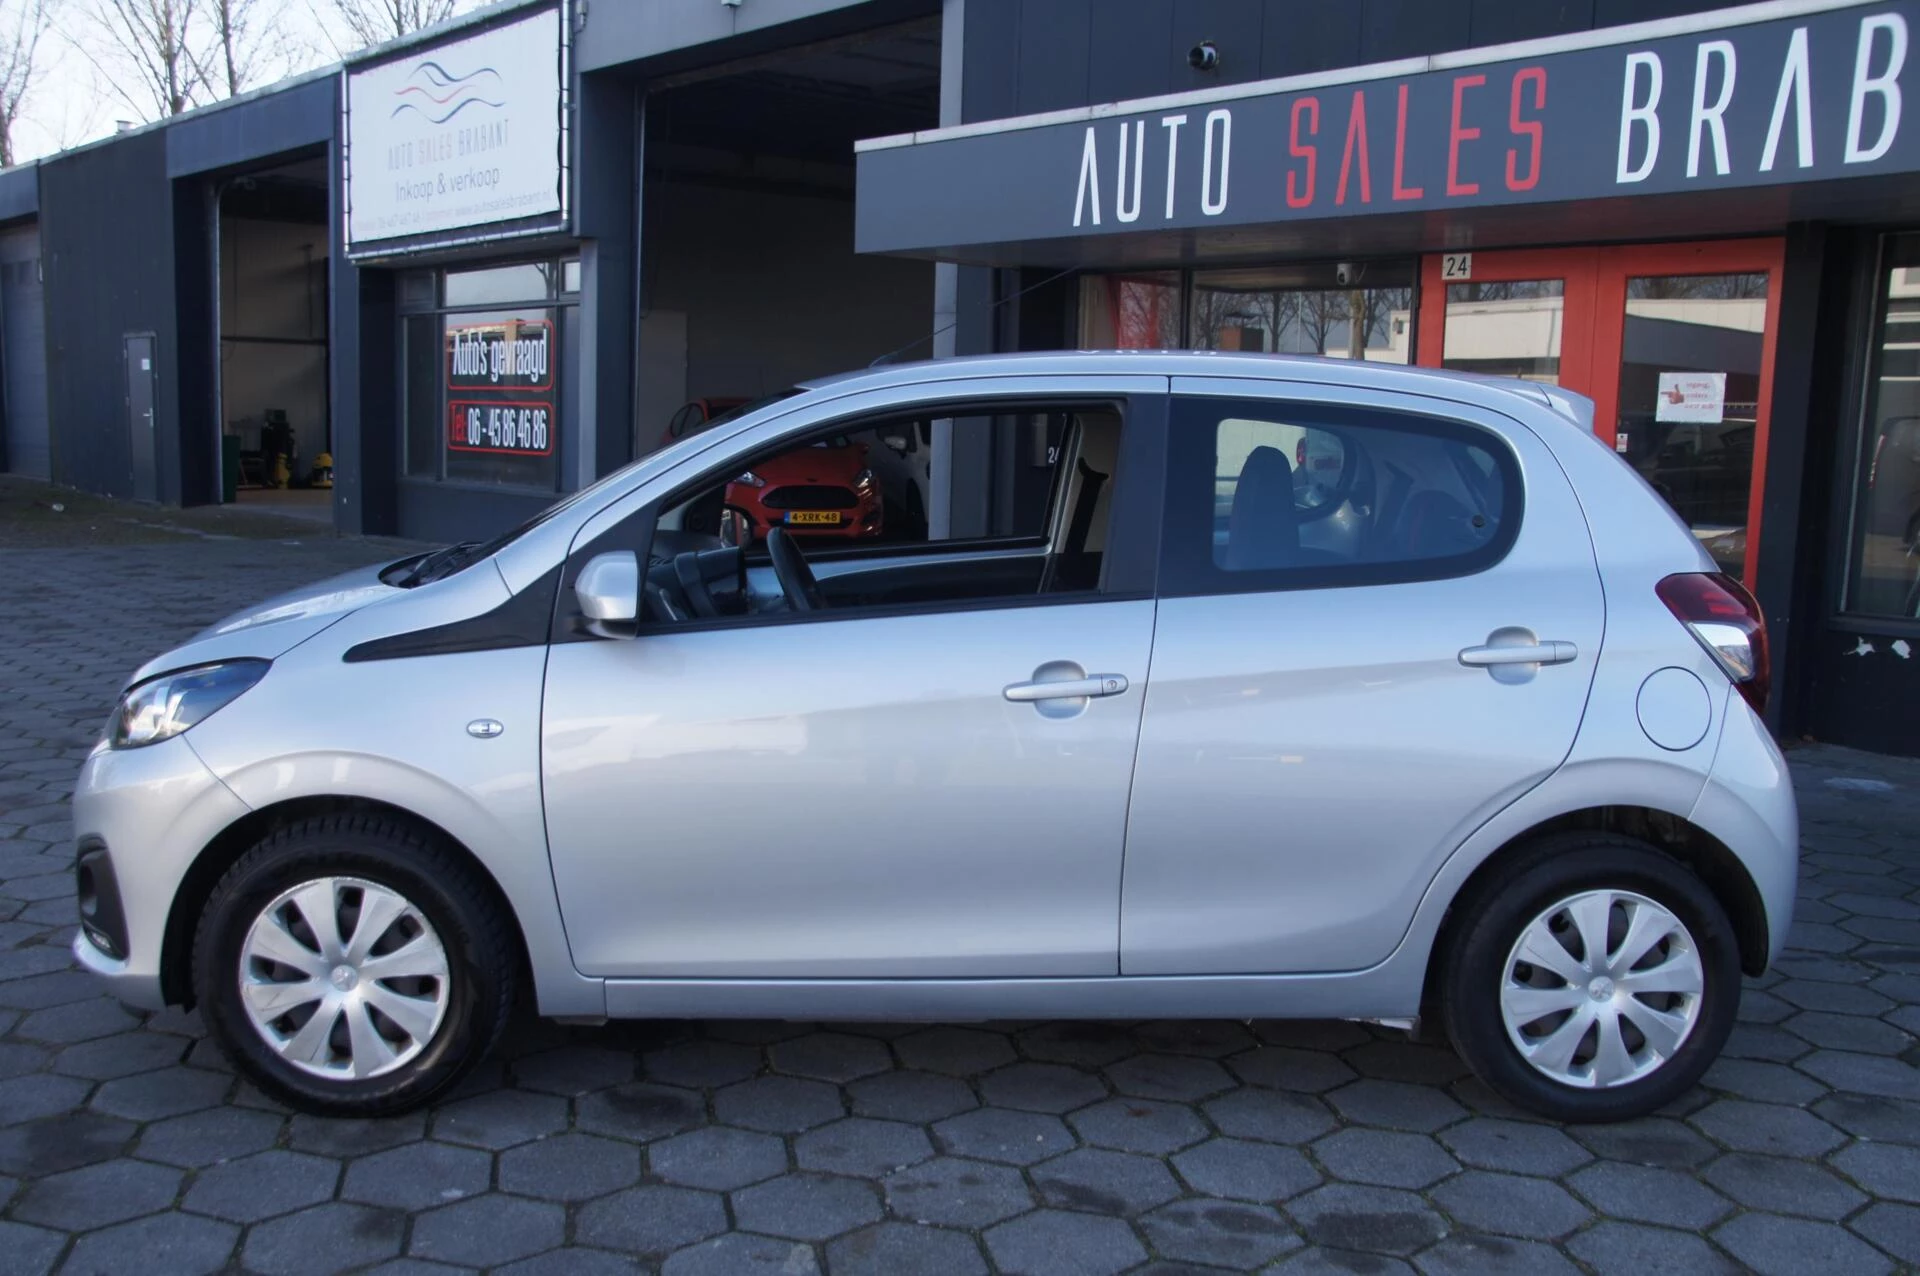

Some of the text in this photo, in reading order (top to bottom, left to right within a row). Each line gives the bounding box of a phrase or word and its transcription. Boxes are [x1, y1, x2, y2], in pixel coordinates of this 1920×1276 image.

[1073, 12, 1909, 228] AUTO SALES BRAB
[388, 119, 509, 171] AUTO SALES BRABANT
[395, 167, 500, 203] Inkoop & verkoop
[1447, 256, 1467, 276] 24
[453, 328, 547, 382] Auto's gevraagd
[503, 408, 516, 447] 86
[517, 409, 531, 448] 46
[533, 409, 547, 449] 86
[792, 512, 838, 521] 4-XRK-48
